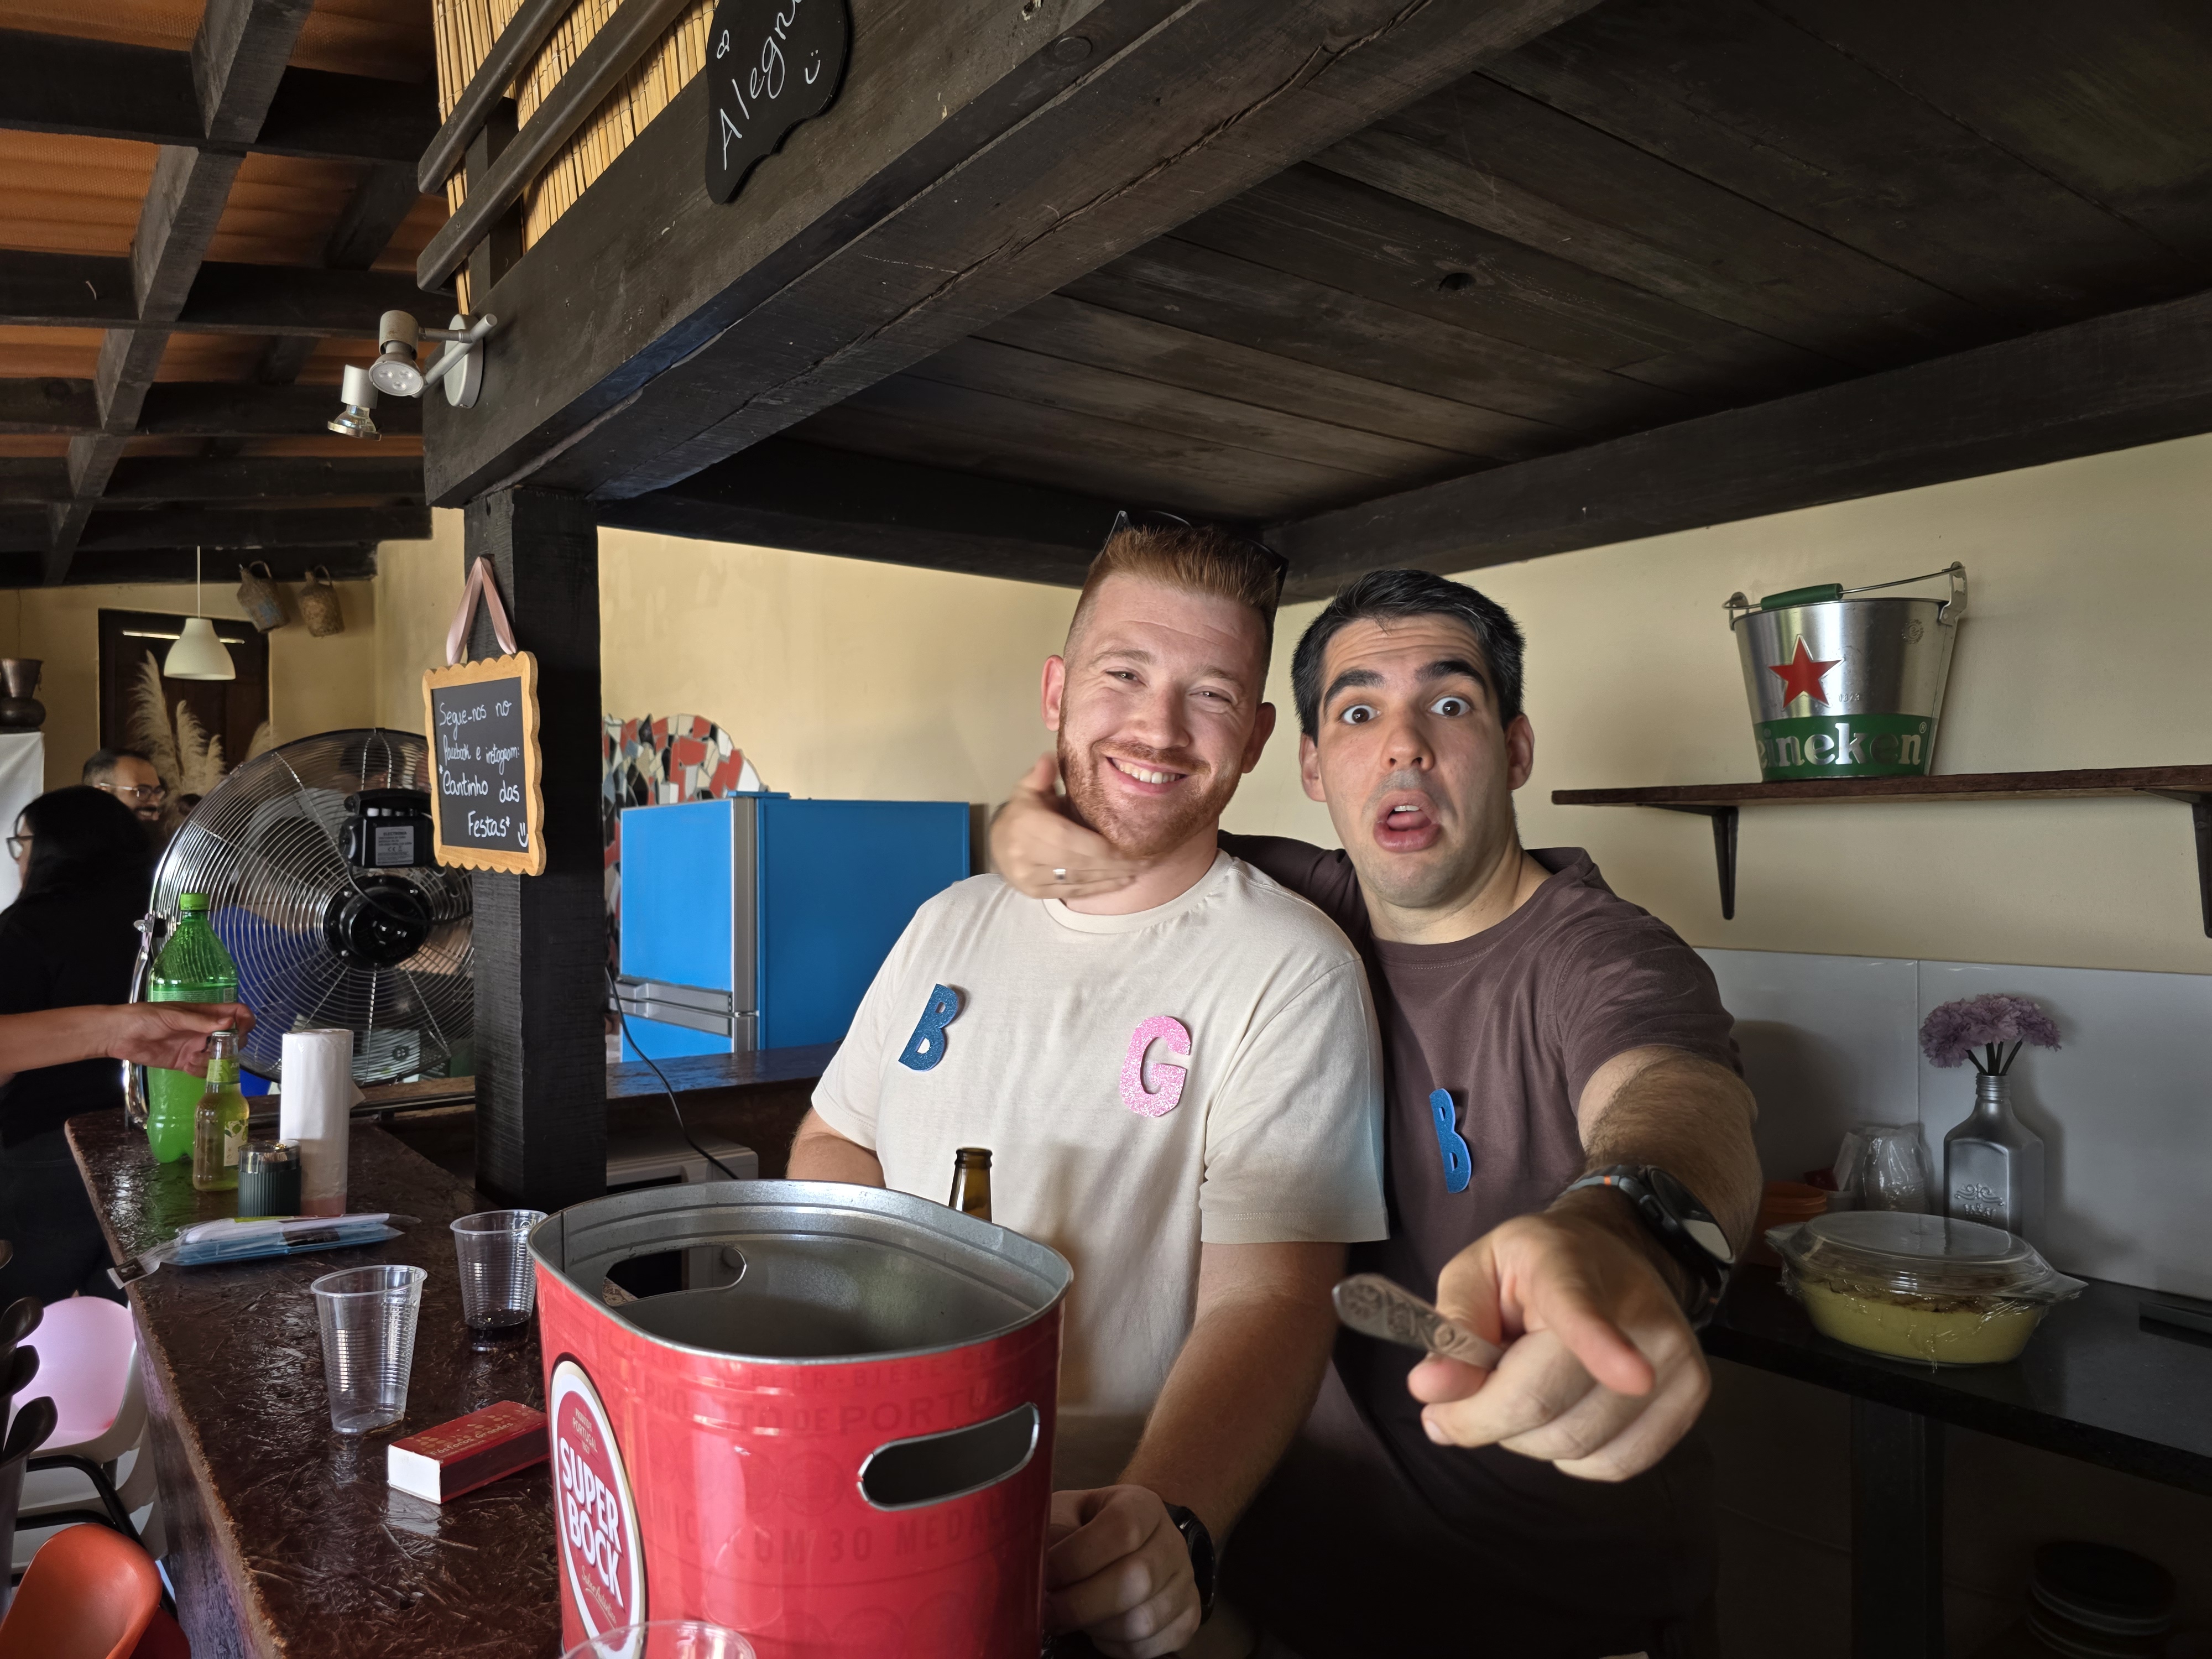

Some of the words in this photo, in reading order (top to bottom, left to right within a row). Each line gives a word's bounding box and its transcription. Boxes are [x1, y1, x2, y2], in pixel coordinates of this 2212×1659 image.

[440, 702, 487, 741] Segue-nos
[495, 700, 512, 717] no
[476, 746, 481, 761] e
[499, 780, 520, 803] das
[899, 984, 958, 1072] B
[1120, 1016, 1191, 1118] G
[1429, 1088, 1472, 1194] B
[429, 1437, 474, 1456] Fósforos
[475, 1422, 514, 1438] Grandes
[560, 1437, 622, 1553] SUPER
[567, 1490, 624, 1609] BOCK
